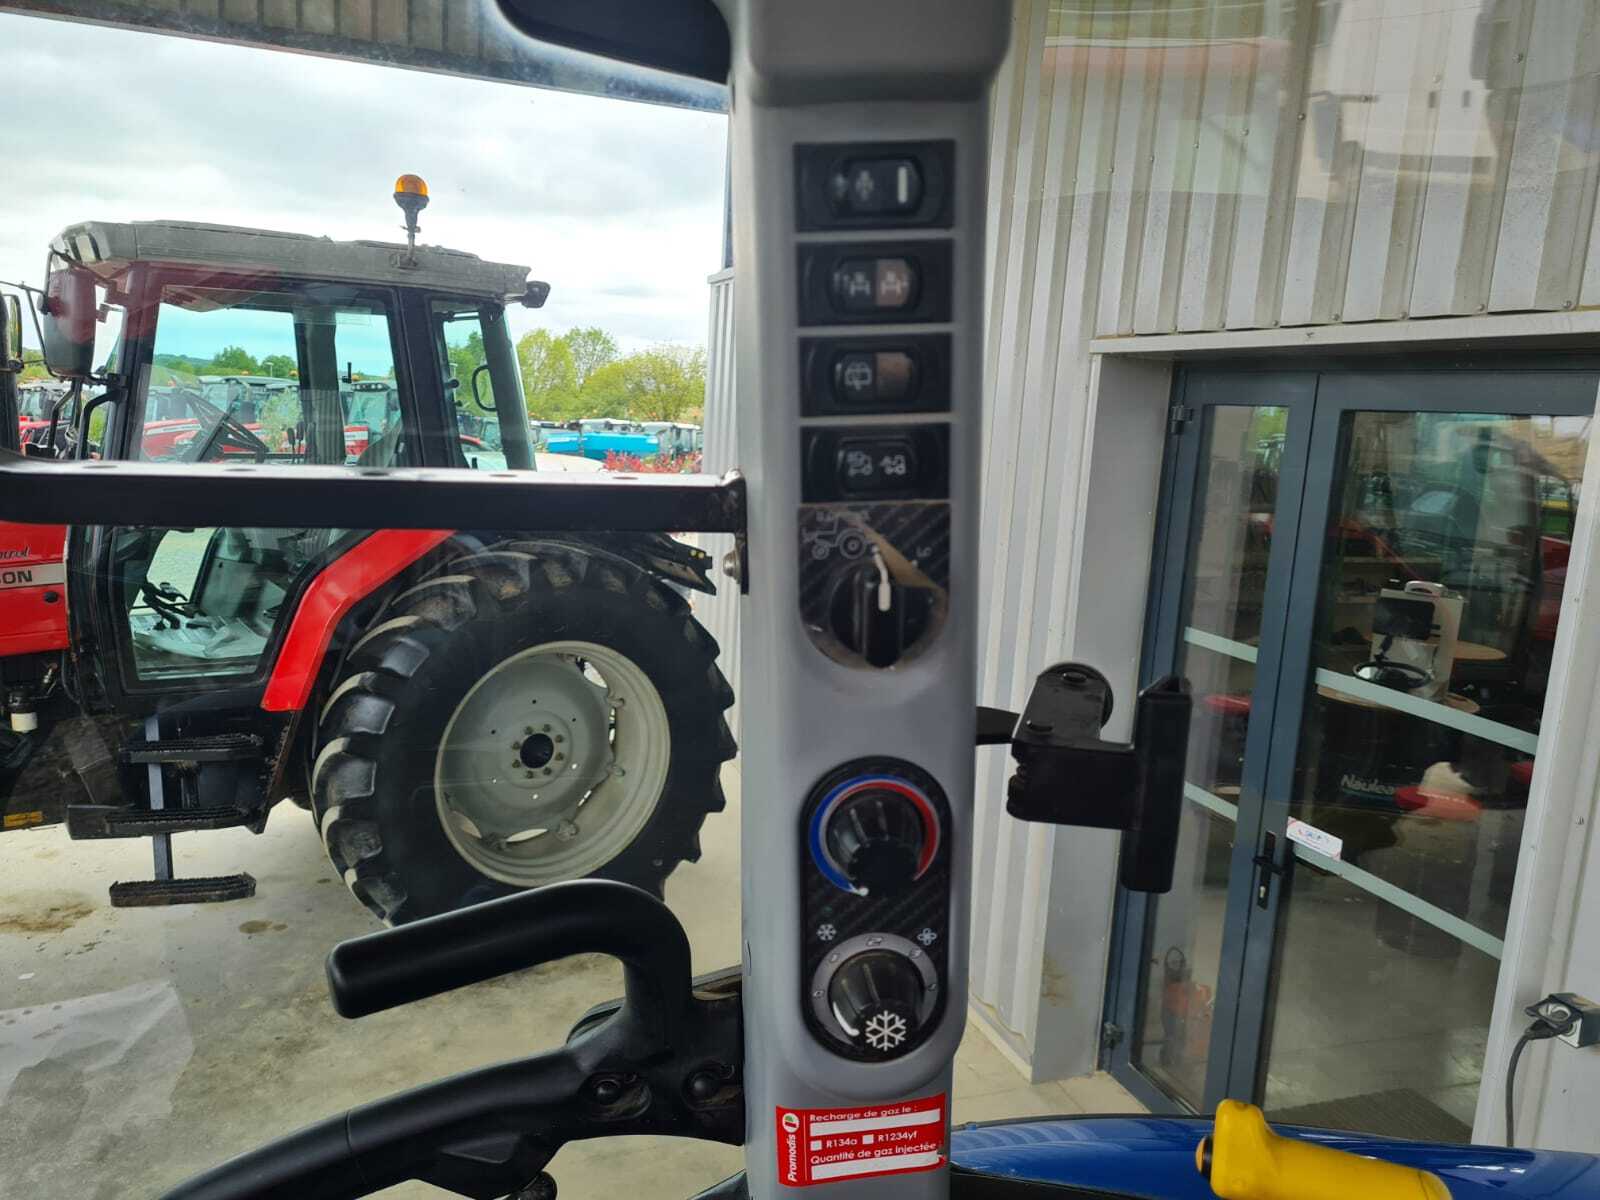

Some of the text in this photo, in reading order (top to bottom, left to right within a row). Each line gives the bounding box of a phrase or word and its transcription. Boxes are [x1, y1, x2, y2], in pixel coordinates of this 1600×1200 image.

[0, 570, 32, 584] ON
[810, 1112, 861, 1122] Recharge
[864, 1110, 878, 1118] de
[880, 1108, 900, 1117] gaz
[878, 1130, 918, 1141] R1234yf
[786, 1134, 798, 1182] Promodis
[811, 1151, 855, 1165] Quantité
[857, 1149, 872, 1158] de
[874, 1148, 894, 1158] gaz
[895, 1142, 937, 1155] injectée
